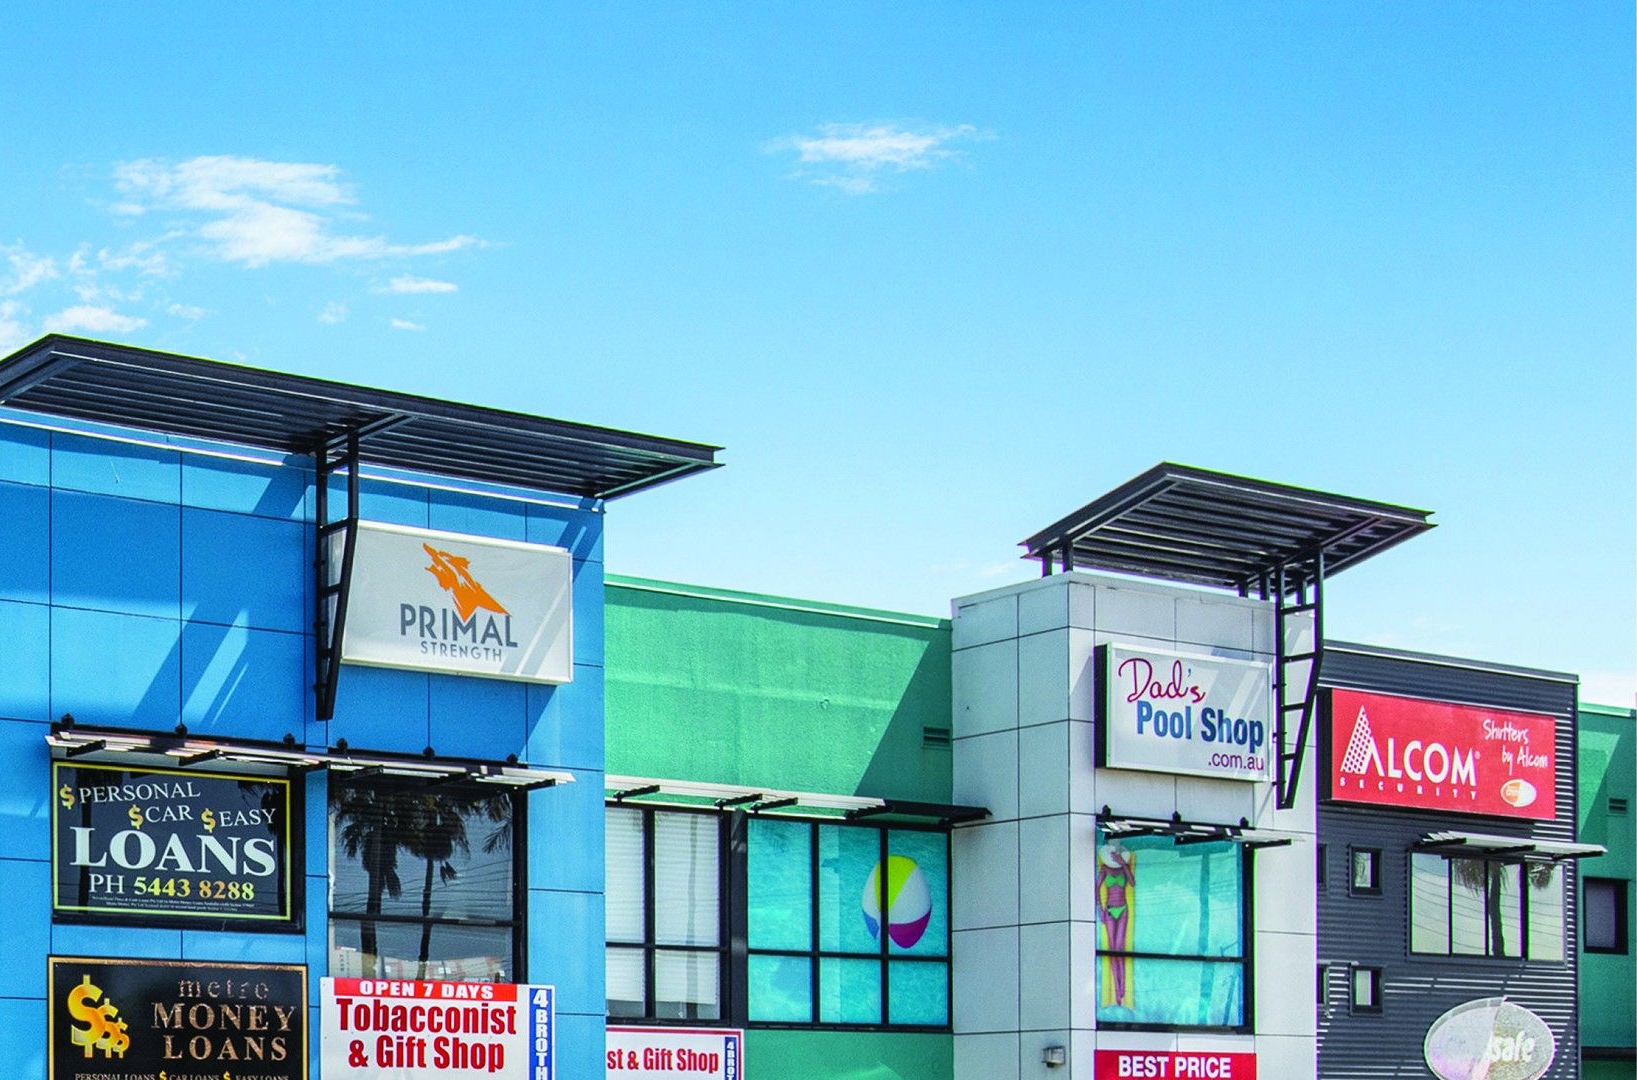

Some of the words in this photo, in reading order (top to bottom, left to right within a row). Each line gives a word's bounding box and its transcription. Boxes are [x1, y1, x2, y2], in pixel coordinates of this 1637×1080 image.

[400, 603, 518, 647] PRIMAL
[421, 640, 502, 662] STRENGTH
[1118, 658, 1206, 703] Dad's
[1137, 700, 1192, 739] Pool
[1201, 707, 1263, 753] Shop
[1483, 719, 1528, 744] Shutters
[1340, 704, 1477, 786] ALCOM
[1208, 753, 1264, 771] .com.au
[1502, 748, 1513, 775] by
[1517, 749, 1548, 768] Alcom
[1340, 776, 1477, 800] SECURITY
[69, 826, 276, 877] LOANS
[89, 873, 124, 894] PH
[134, 876, 190, 898] 5443
[199, 880, 254, 901] 8288
[359, 980, 415, 998] OPEN
[424, 983, 435, 998] 7
[442, 983, 494, 999] DAYS
[151, 1001, 296, 1032] MONEY
[336, 998, 517, 1035] Tobacconist
[163, 1035, 287, 1061] LOANS
[348, 1039, 369, 1068] &
[376, 1035, 427, 1068] Gift
[434, 1036, 505, 1073] Shop
[627, 1052, 639, 1070] &
[643, 1049, 673, 1071] Gift
[676, 1048, 719, 1074] Shop
[1118, 1056, 1168, 1078] BEST
[1174, 1056, 1231, 1078] PRICE
